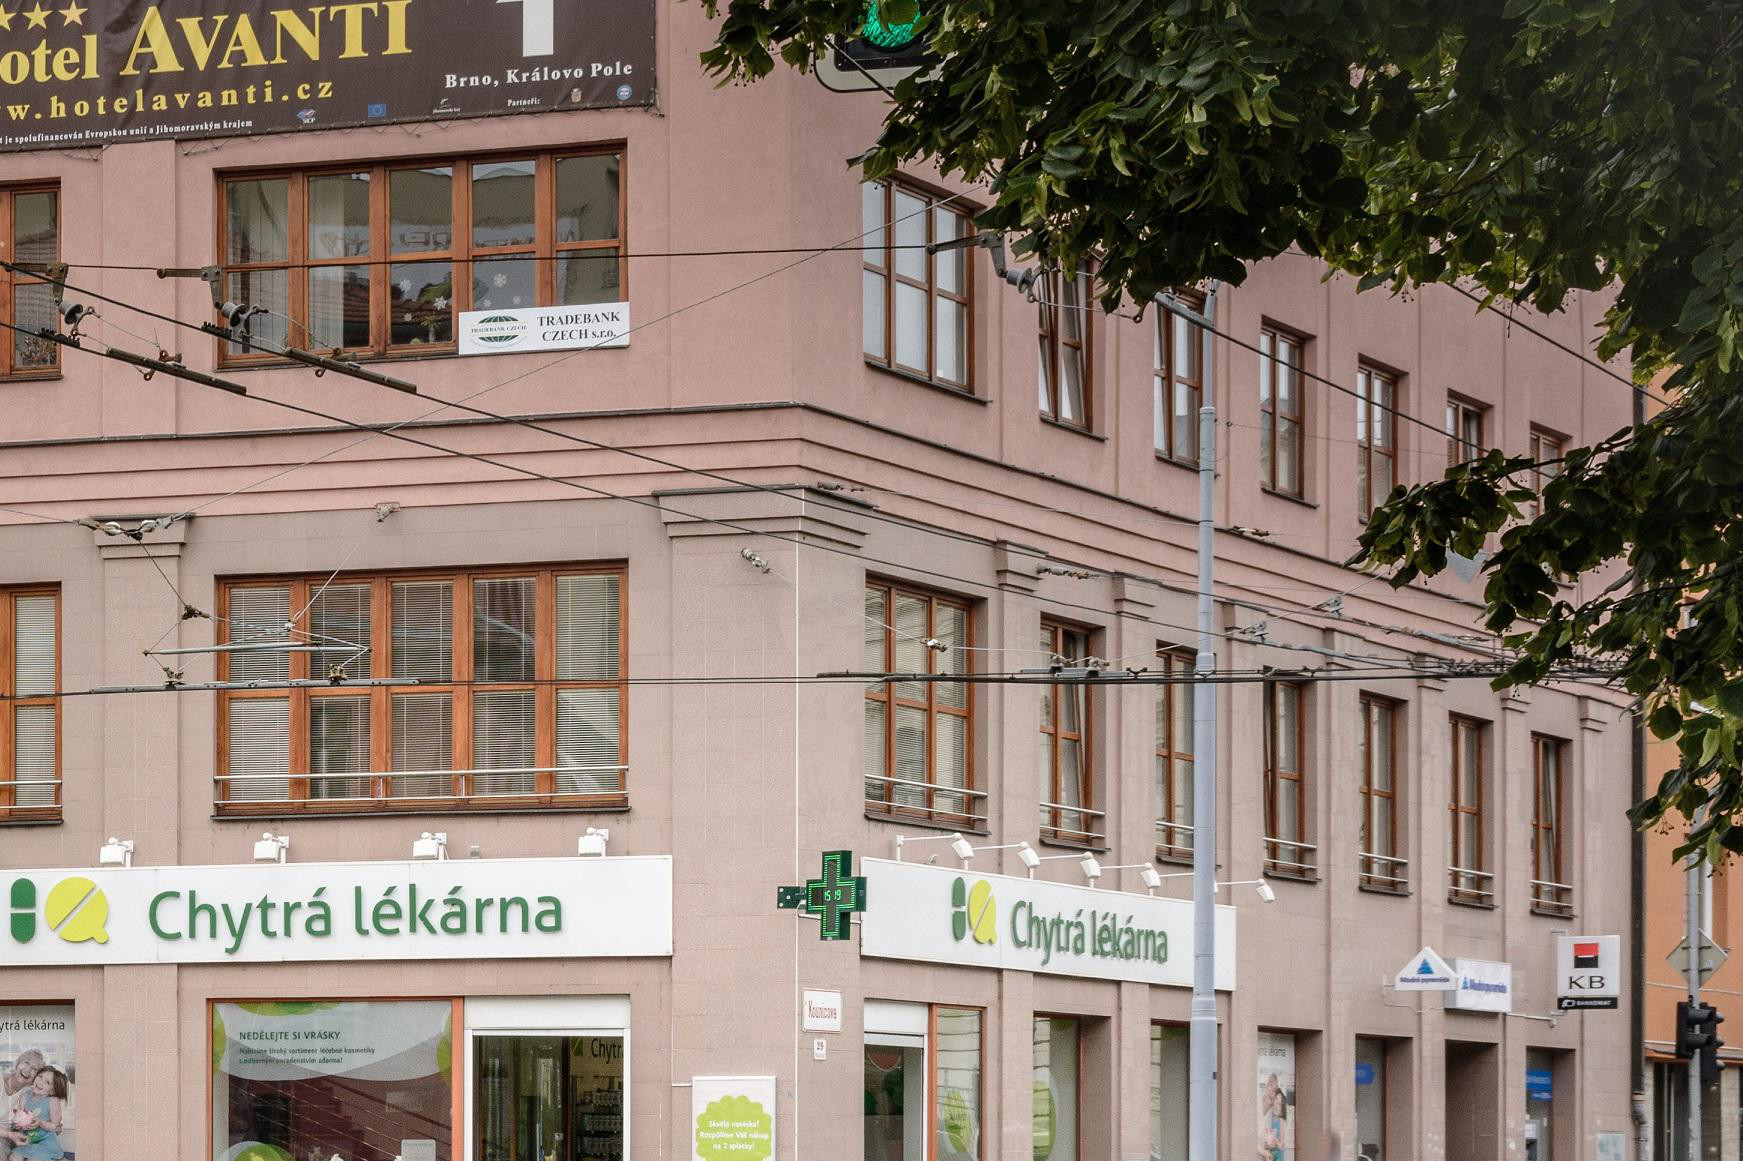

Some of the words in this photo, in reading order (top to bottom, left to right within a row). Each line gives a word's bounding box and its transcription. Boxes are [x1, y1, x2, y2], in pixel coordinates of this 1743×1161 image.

[119, 0, 413, 76] AVANTI
[445, 73, 500, 89] Brno,
[506, 66, 583, 84] Královo
[590, 60, 633, 78] Pole
[5, 135, 13, 145] je
[14, 131, 83, 144] spolufinancován
[85, 128, 127, 140] Evropskou
[129, 125, 147, 135] unií
[155, 121, 221, 135] Jihomoravským
[223, 119, 253, 130] krajem
[537, 311, 621, 327] TRADEBANK
[471, 326, 506, 334] TRADEBANK
[542, 328, 588, 342] CZECH
[591, 329, 617, 339] s.r.o.
[149, 886, 332, 954] Chytrá
[354, 883, 563, 936] lékárna
[1011, 900, 1086, 966] Chytrá
[1090, 909, 1169, 964] lékárna
[1568, 975, 1605, 989] KB
[23, 1019, 65, 1031] lékárna
[239, 1030, 289, 1042] NEDĚLEJTE
[292, 1031, 301, 1040] SI
[303, 1029, 341, 1040] VRÁSKY
[591, 1038, 624, 1064] Chytr
